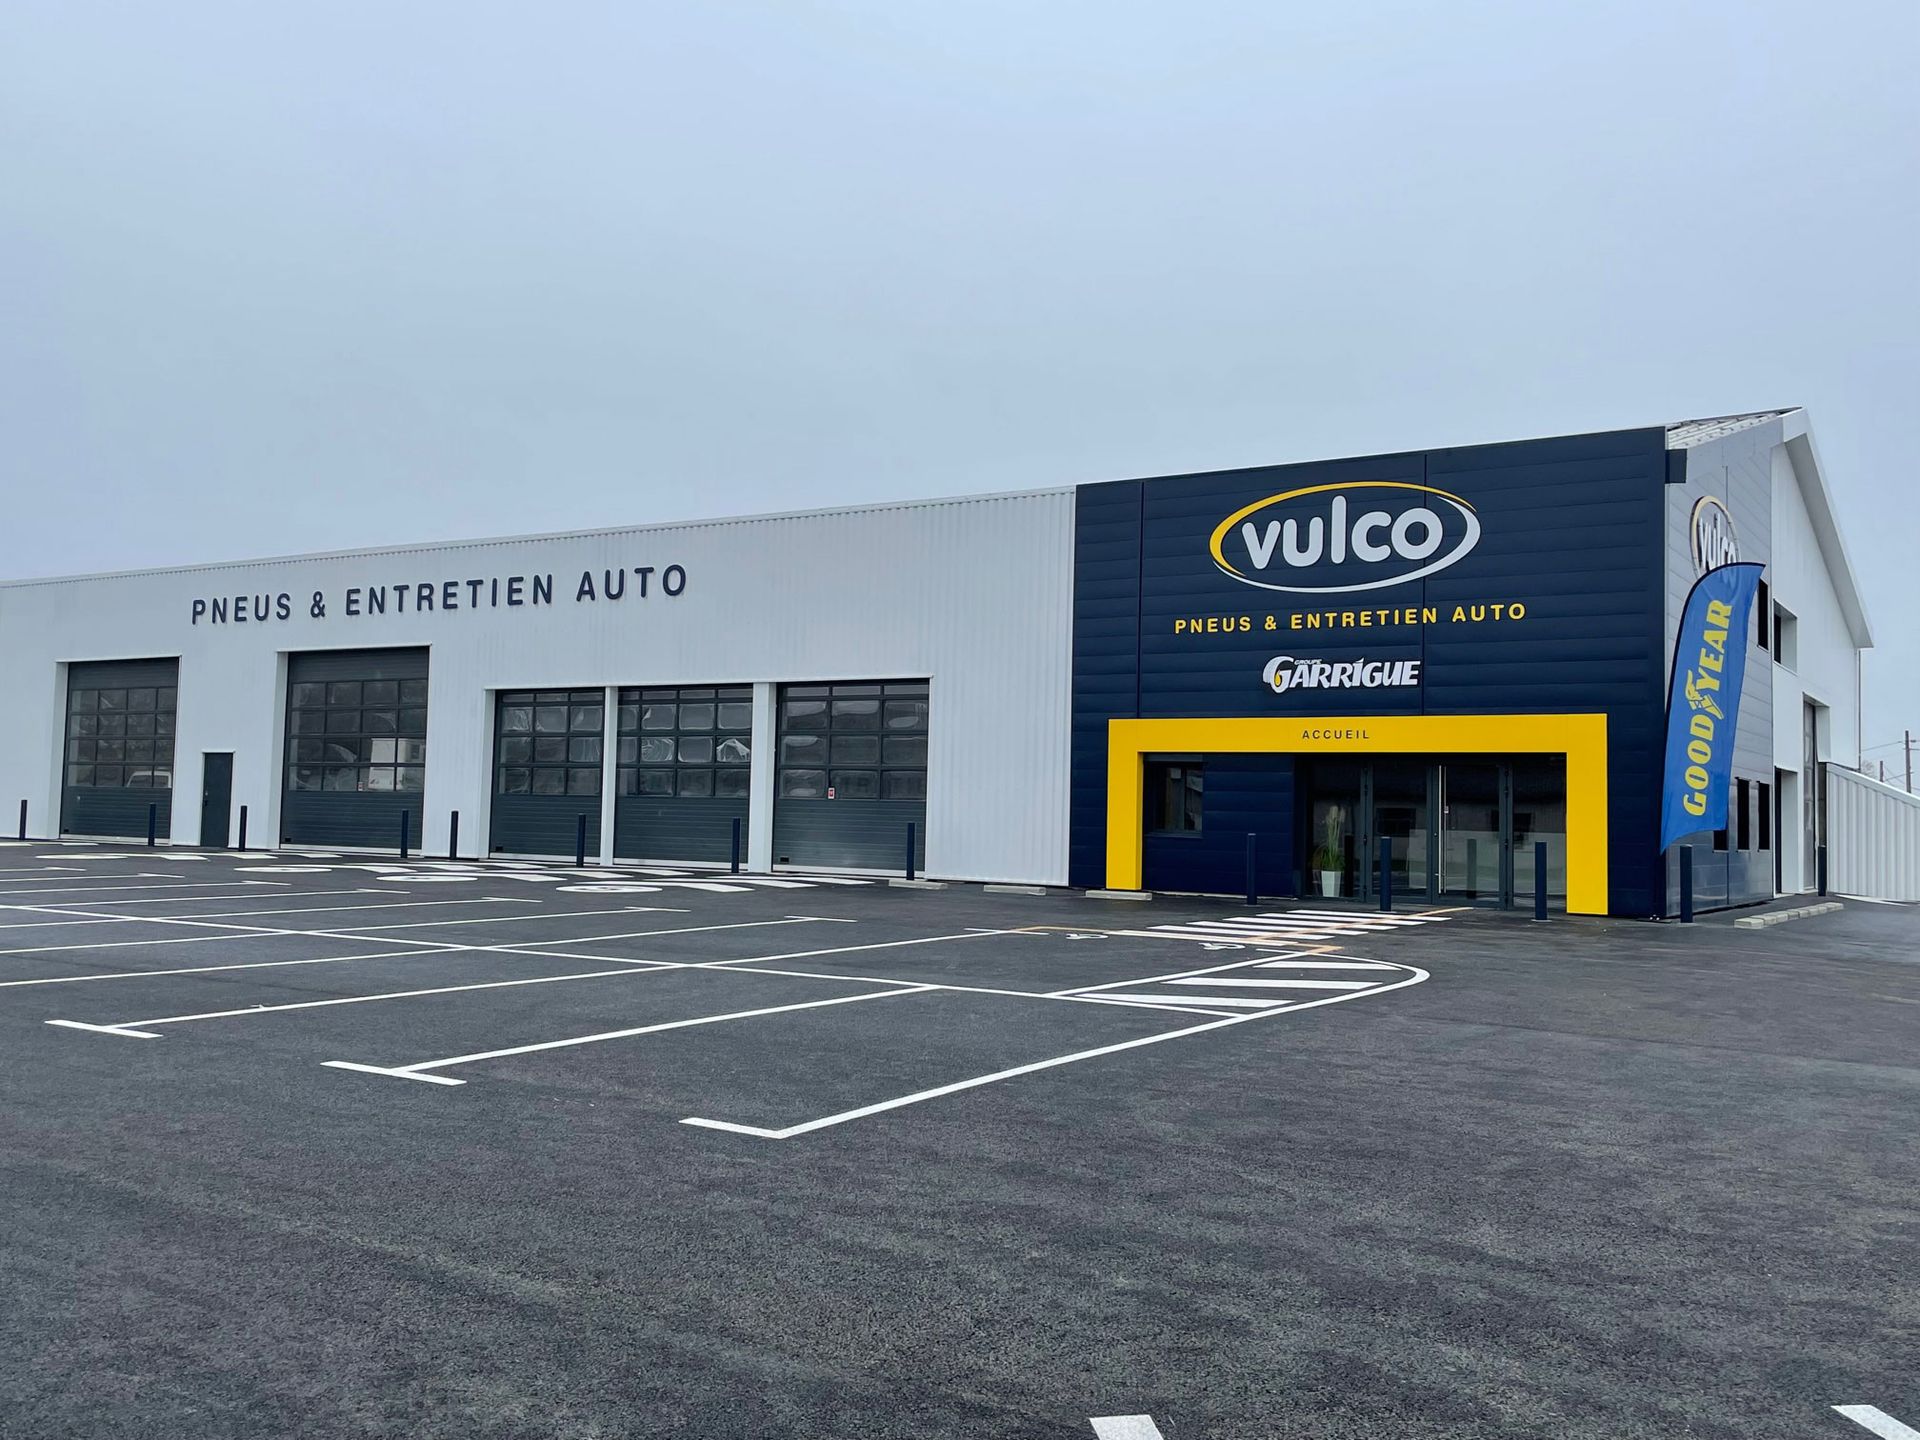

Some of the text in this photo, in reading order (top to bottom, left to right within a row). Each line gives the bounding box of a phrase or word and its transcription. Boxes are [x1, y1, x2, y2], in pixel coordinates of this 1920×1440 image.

[1241, 494, 1444, 570] vulco
[191, 564, 687, 625] PNEUS & ENTRETIEN AUTO
[1175, 603, 1526, 634] PNEUS & ENTRETIEN AUTO
[1302, 729, 1370, 740] ACCUEIL
[1683, 600, 1732, 816] GOODYEAR
